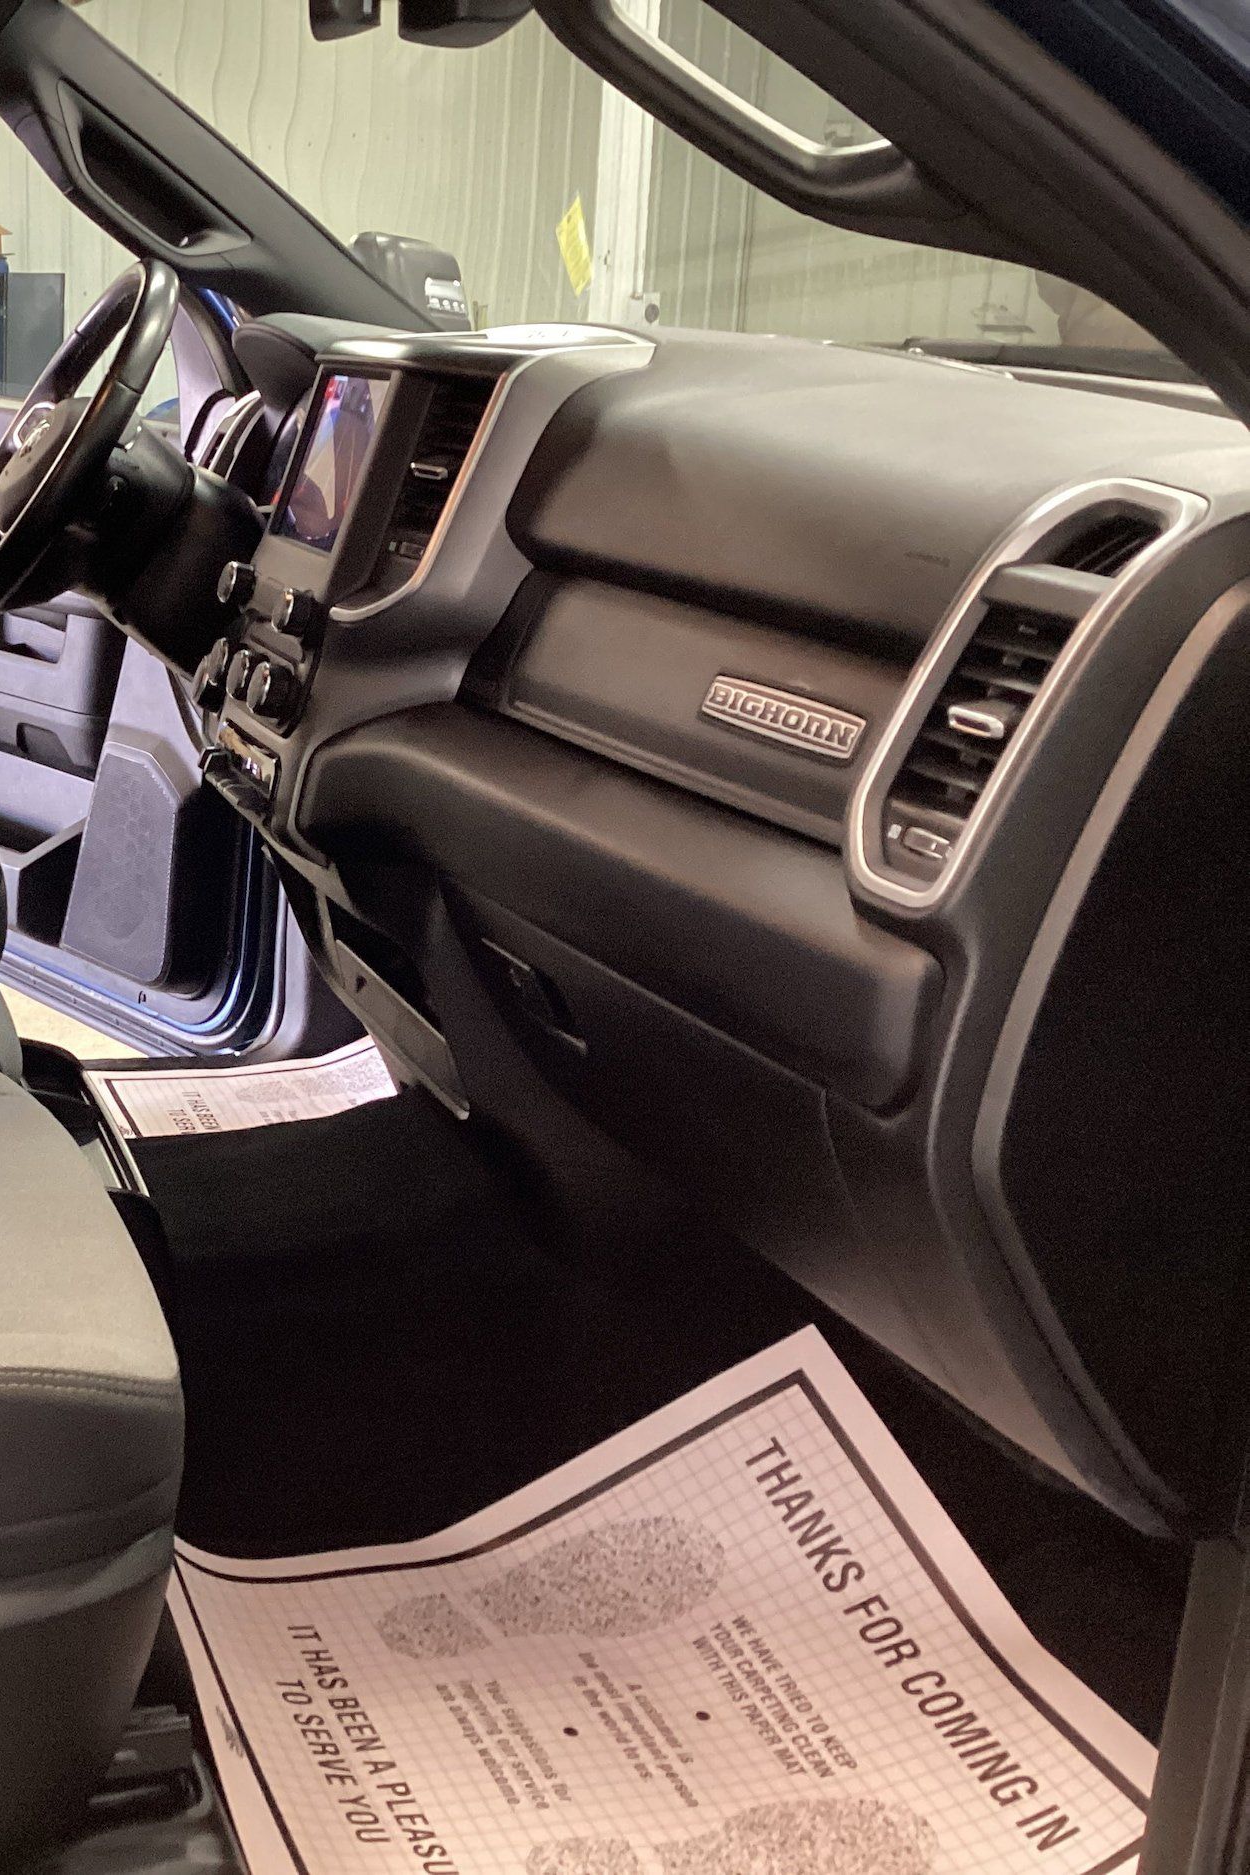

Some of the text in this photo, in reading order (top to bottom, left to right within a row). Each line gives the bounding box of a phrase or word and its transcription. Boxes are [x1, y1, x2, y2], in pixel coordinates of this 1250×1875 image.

[707, 684, 857, 751] BIGHORN
[187, 1099, 210, 1112] HAS
[692, 1636, 807, 1775] WITH THIS PAPER MAT
[710, 1622, 836, 1778] YOUR CARPETING CLEAN
[732, 1615, 858, 1769] WE HAVE TRIED TO KEEP
[745, 1436, 1081, 1853] THANKS FOR COMING IN
[276, 1679, 392, 1843] TO SERVE YOU
[287, 1624, 460, 1875] IT HAS BEEN A PLEASU
